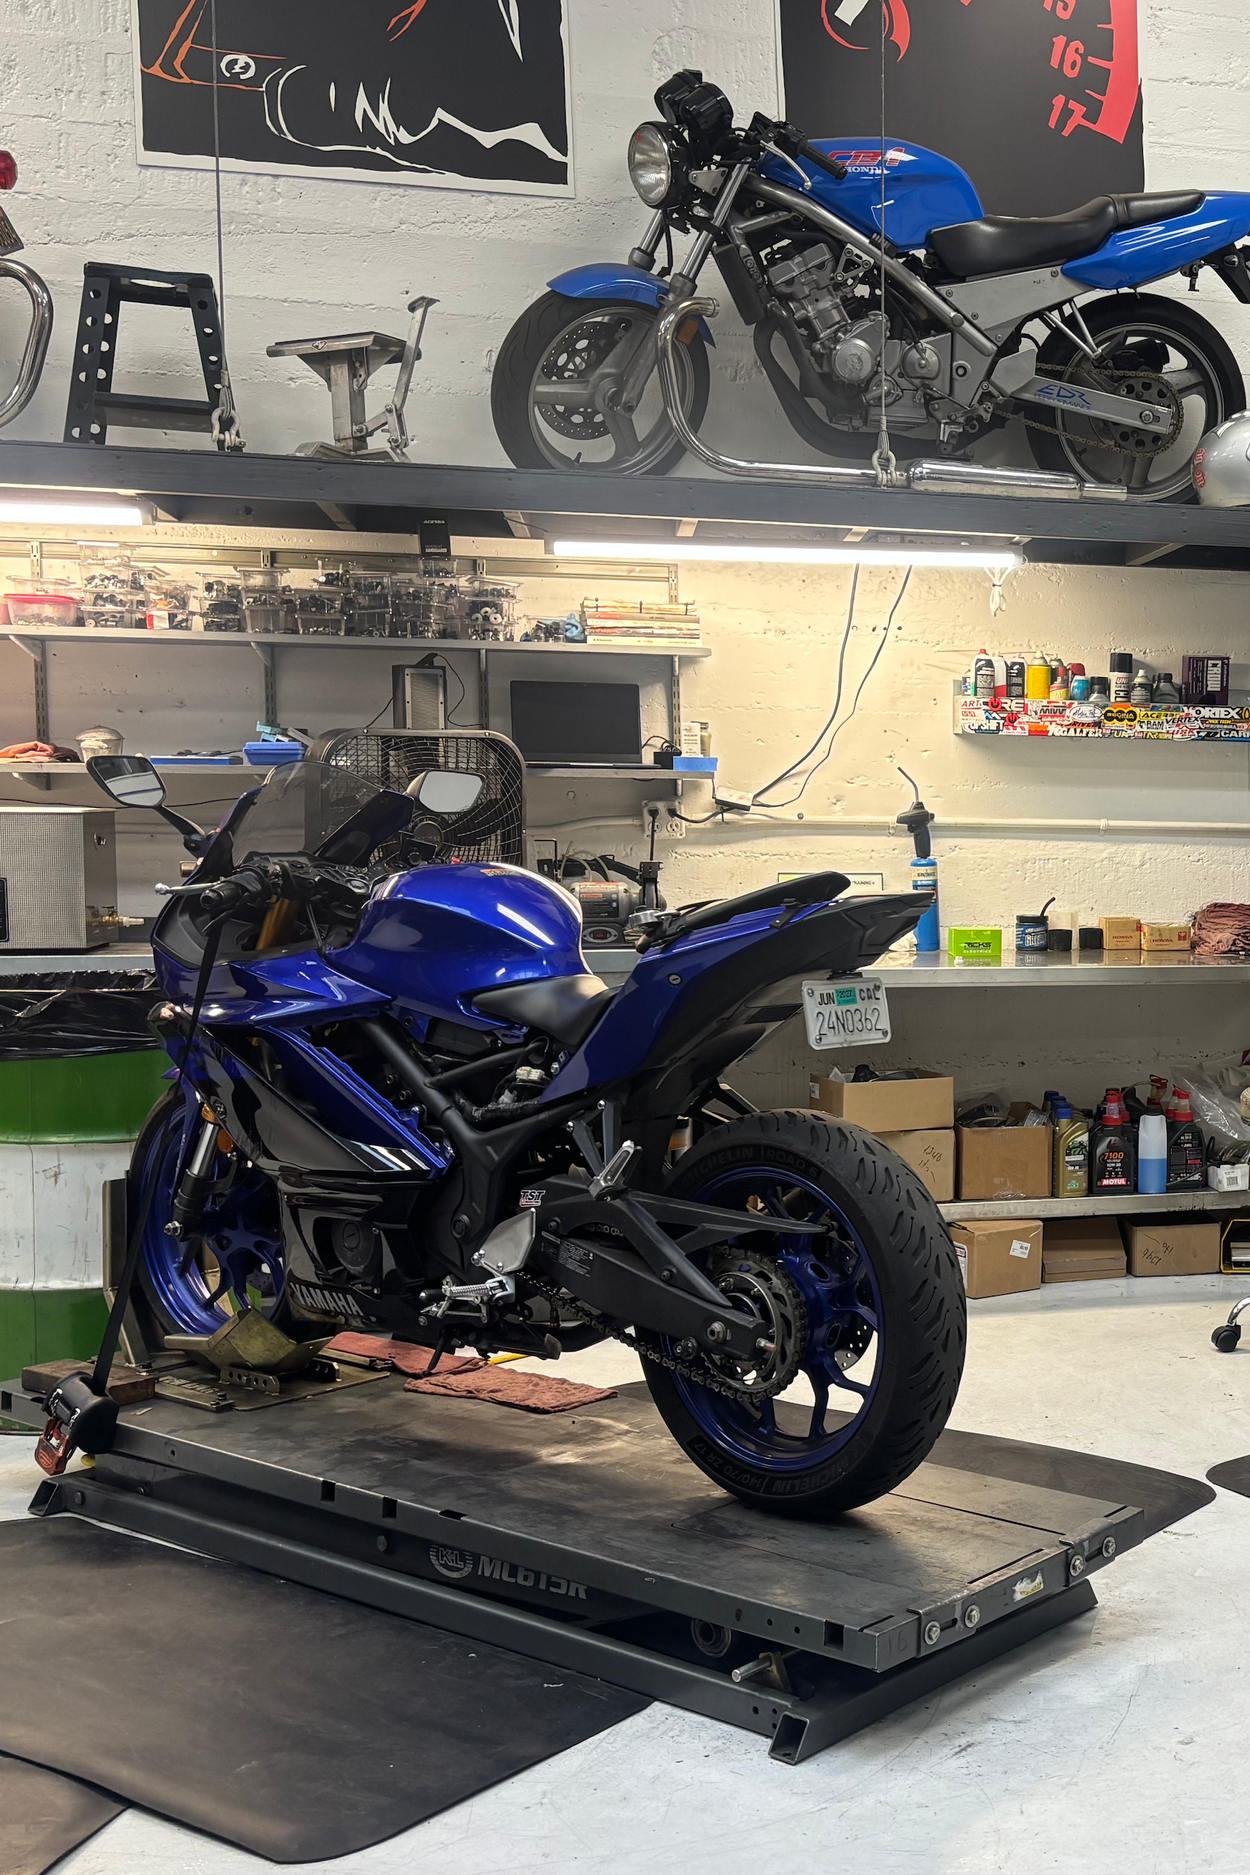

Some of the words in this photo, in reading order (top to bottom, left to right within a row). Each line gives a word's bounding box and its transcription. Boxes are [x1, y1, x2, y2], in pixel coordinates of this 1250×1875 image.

[1050, 35, 1084, 78] 16
[1048, 93, 1087, 137] 17
[1037, 384, 1092, 405] EDR
[1106, 711, 1135, 720] REGINA
[1165, 716, 1200, 725] VERTEX
[1183, 706, 1241, 719] VORTEX
[1146, 720, 1164, 728] RAM
[818, 992, 835, 1006] JUN
[859, 986, 880, 1001] CAL
[816, 1007, 883, 1036] 24N0362
[766, 1149, 807, 1170] ROAD
[1104, 1152, 1125, 1160] 7100
[1102, 1178, 1127, 1186] MOTUL
[520, 1190, 546, 1201] TST
[290, 1282, 364, 1316] YAMAHA
[723, 1464, 762, 1489] 140/70
